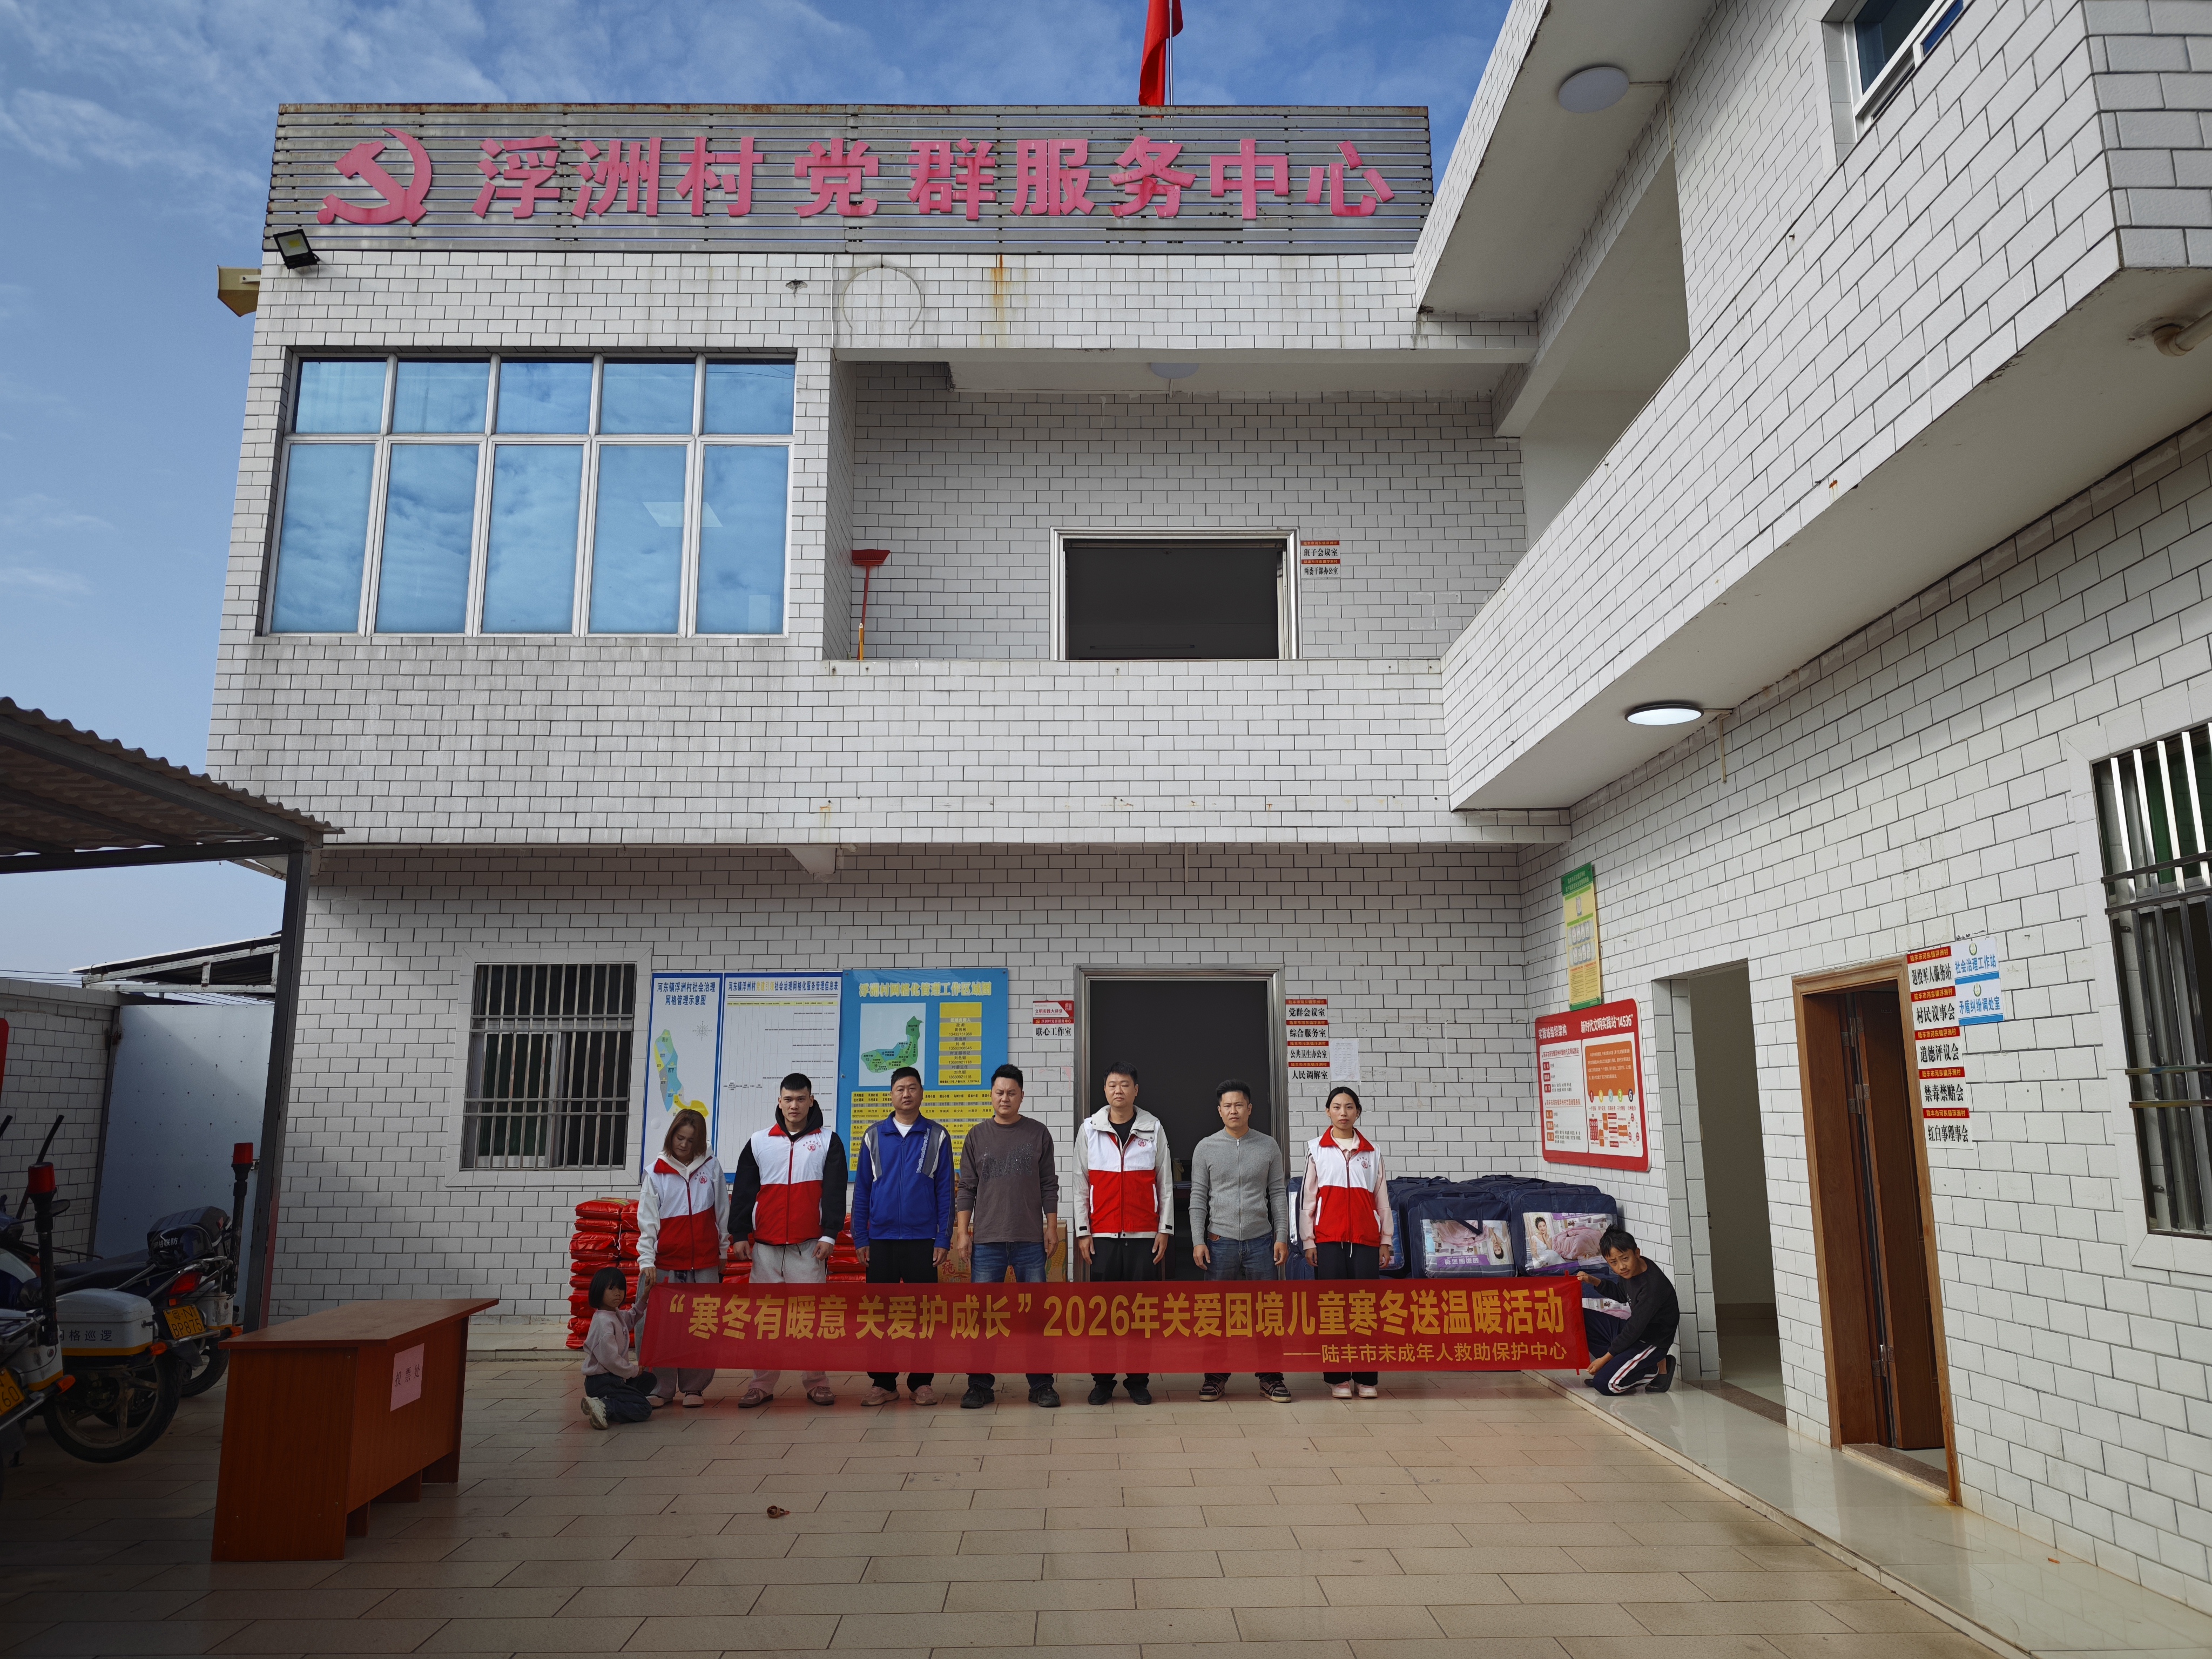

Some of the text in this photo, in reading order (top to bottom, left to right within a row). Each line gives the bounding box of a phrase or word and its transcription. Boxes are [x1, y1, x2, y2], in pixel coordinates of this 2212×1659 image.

[472, 134, 1395, 220] 浮洲村党群服务中心
[1304, 548, 1338, 557] 班子会议室
[1304, 567, 1338, 576] 两委干部办公室
[1910, 948, 1949, 962] 陆丰市河东镇浮洲村
[1954, 954, 1997, 974] 社会治理工作站
[1912, 962, 1952, 986] 退役军人服务站
[657, 982, 716, 993] 河东镇浮洲村社会治理
[859, 981, 992, 997] 浮洲村网格化管理工作区域图
[1914, 988, 1953, 1000] 陆丰市河东镇浮洲村
[665, 994, 706, 1006] 网格管理示意图
[1959, 995, 2001, 1015] 矛盾纠纷调处室
[1289, 1008, 1325, 1017] 党群会议室
[1916, 1002, 1955, 1024] 村民议事会
[1036, 1027, 1071, 1036] 联心工作室
[1290, 1028, 1326, 1038] 综合服务室
[1538, 1024, 1567, 1040] 实践站组织架构
[1918, 1028, 1957, 1038] 陆丰市河东镇浮洲村
[1290, 1049, 1327, 1058] 公共卫生办公室
[1920, 1043, 1959, 1063] 道德评议会
[1292, 1070, 1328, 1080] 人民调解室
[1922, 1068, 1961, 1078] 陆丰市河东镇浮洲村
[1924, 1083, 1964, 1102] 禁毒禁赌会
[1926, 1109, 1966, 1117] 陆丰市河东镇浮洲村
[1927, 1124, 1969, 1142] 红白事理事会
[172, 1307, 194, 1321] 粤·N
[669, 1288, 1565, 1340] “寒冬有暖意 关爱护成长”2026年关爱困境儿童寒冬送温暖活动
[171, 1318, 203, 1337] BP875
[1284, 1341, 1567, 1364] ——陆丰市未成年人救助保护中心
[395, 1364, 420, 1387] 投票处
